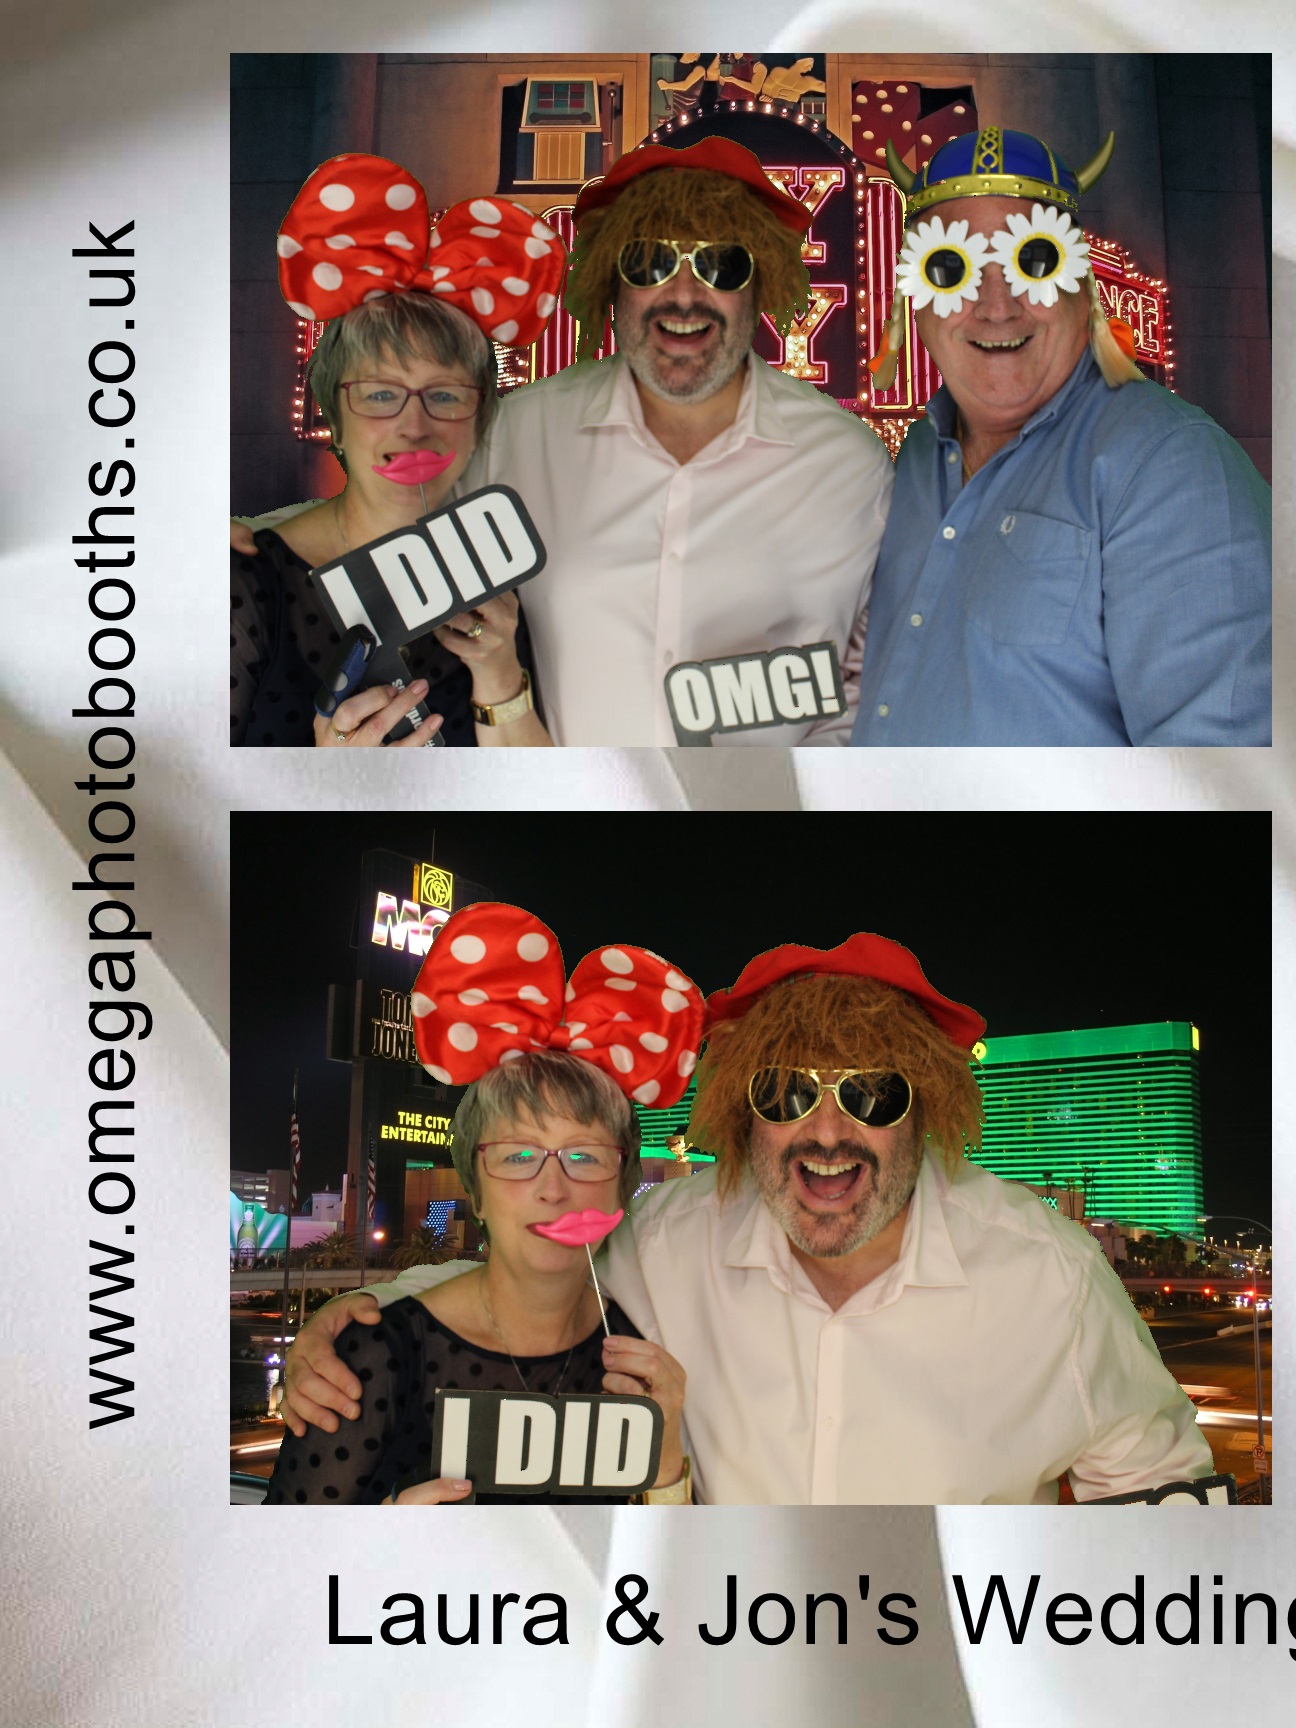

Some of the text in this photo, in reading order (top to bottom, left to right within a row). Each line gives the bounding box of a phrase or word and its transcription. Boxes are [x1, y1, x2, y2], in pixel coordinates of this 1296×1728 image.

[320, 492, 537, 647] I DID
[670, 650, 840, 732] OMG!
[398, 1111, 451, 1131] THE CITY
[440, 1398, 653, 1487] I DID
